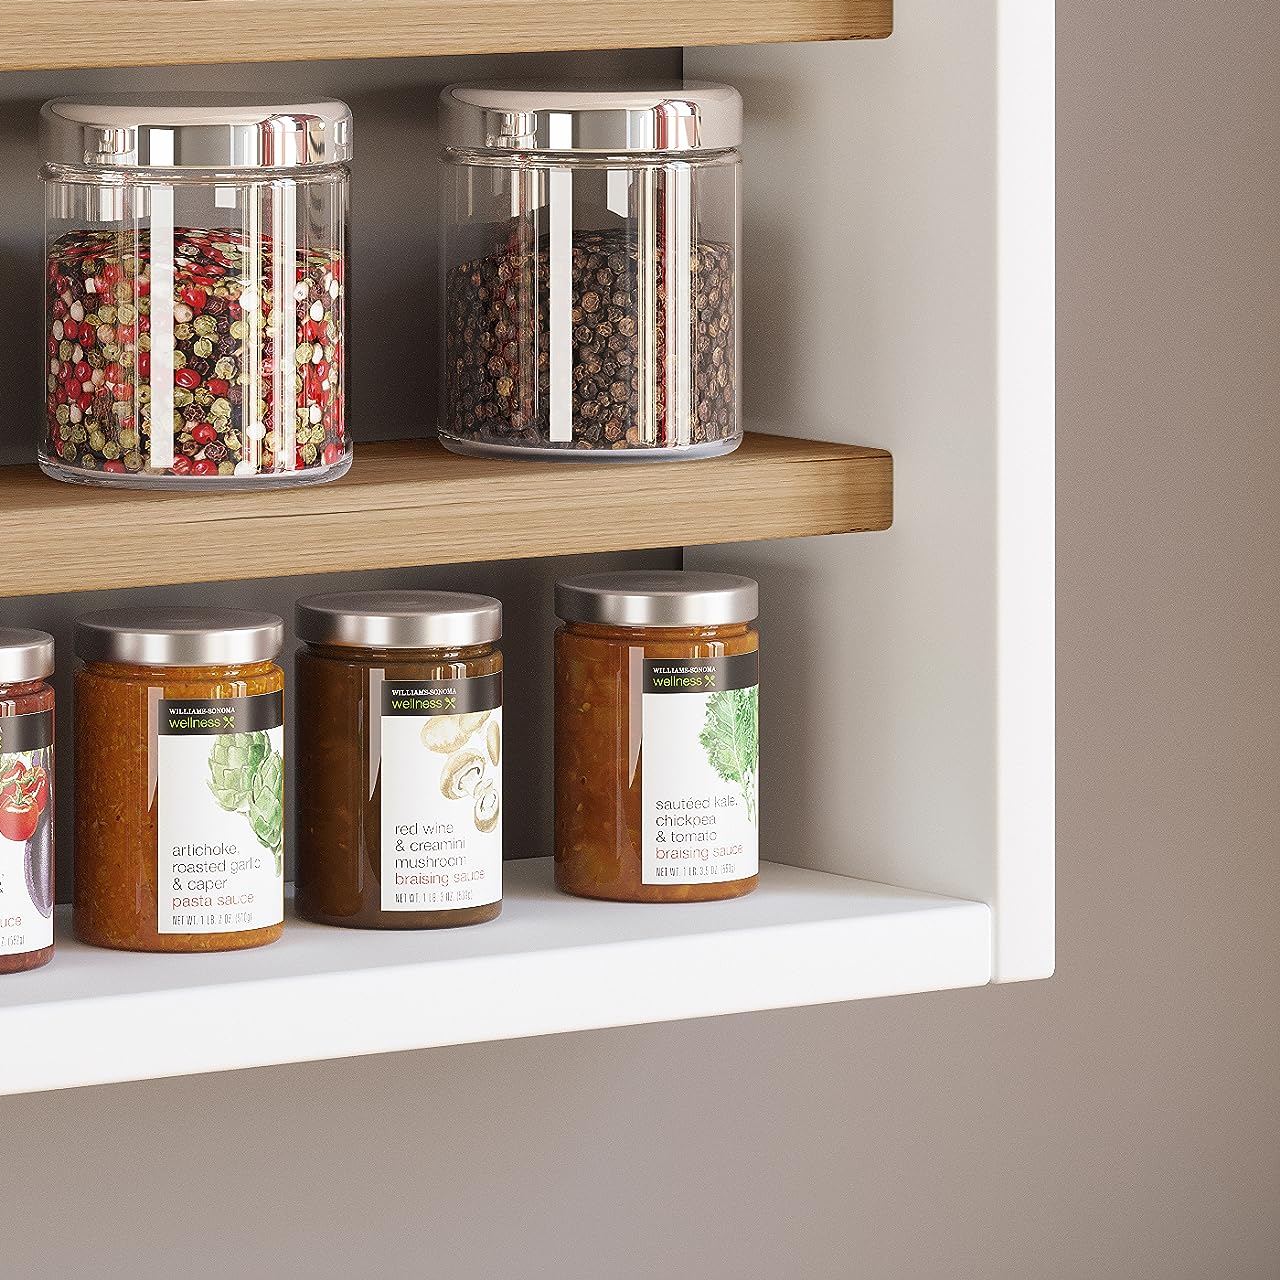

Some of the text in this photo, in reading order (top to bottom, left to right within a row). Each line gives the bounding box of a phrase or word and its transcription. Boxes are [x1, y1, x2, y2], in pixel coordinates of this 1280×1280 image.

[653, 666, 716, 674] WILLIAMS-SONOMA
[653, 676, 702, 687] wellness
[392, 688, 456, 696] WILLIAMS-SONOMA
[392, 698, 442, 709] wellness
[169, 707, 235, 715] WILLIAMS-SONOMA
[169, 717, 221, 728] wellness
[655, 814, 716, 828] chickpea
[395, 822, 454, 835] red wine
[655, 830, 717, 843] & tomato
[172, 842, 240, 856] artichoke,
[395, 837, 465, 852] & creamini
[656, 847, 709, 861] braising
[172, 859, 226, 873] roasted
[172, 877, 227, 892] & caper
[395, 872, 449, 887] braising
[172, 895, 212, 910] pasta
